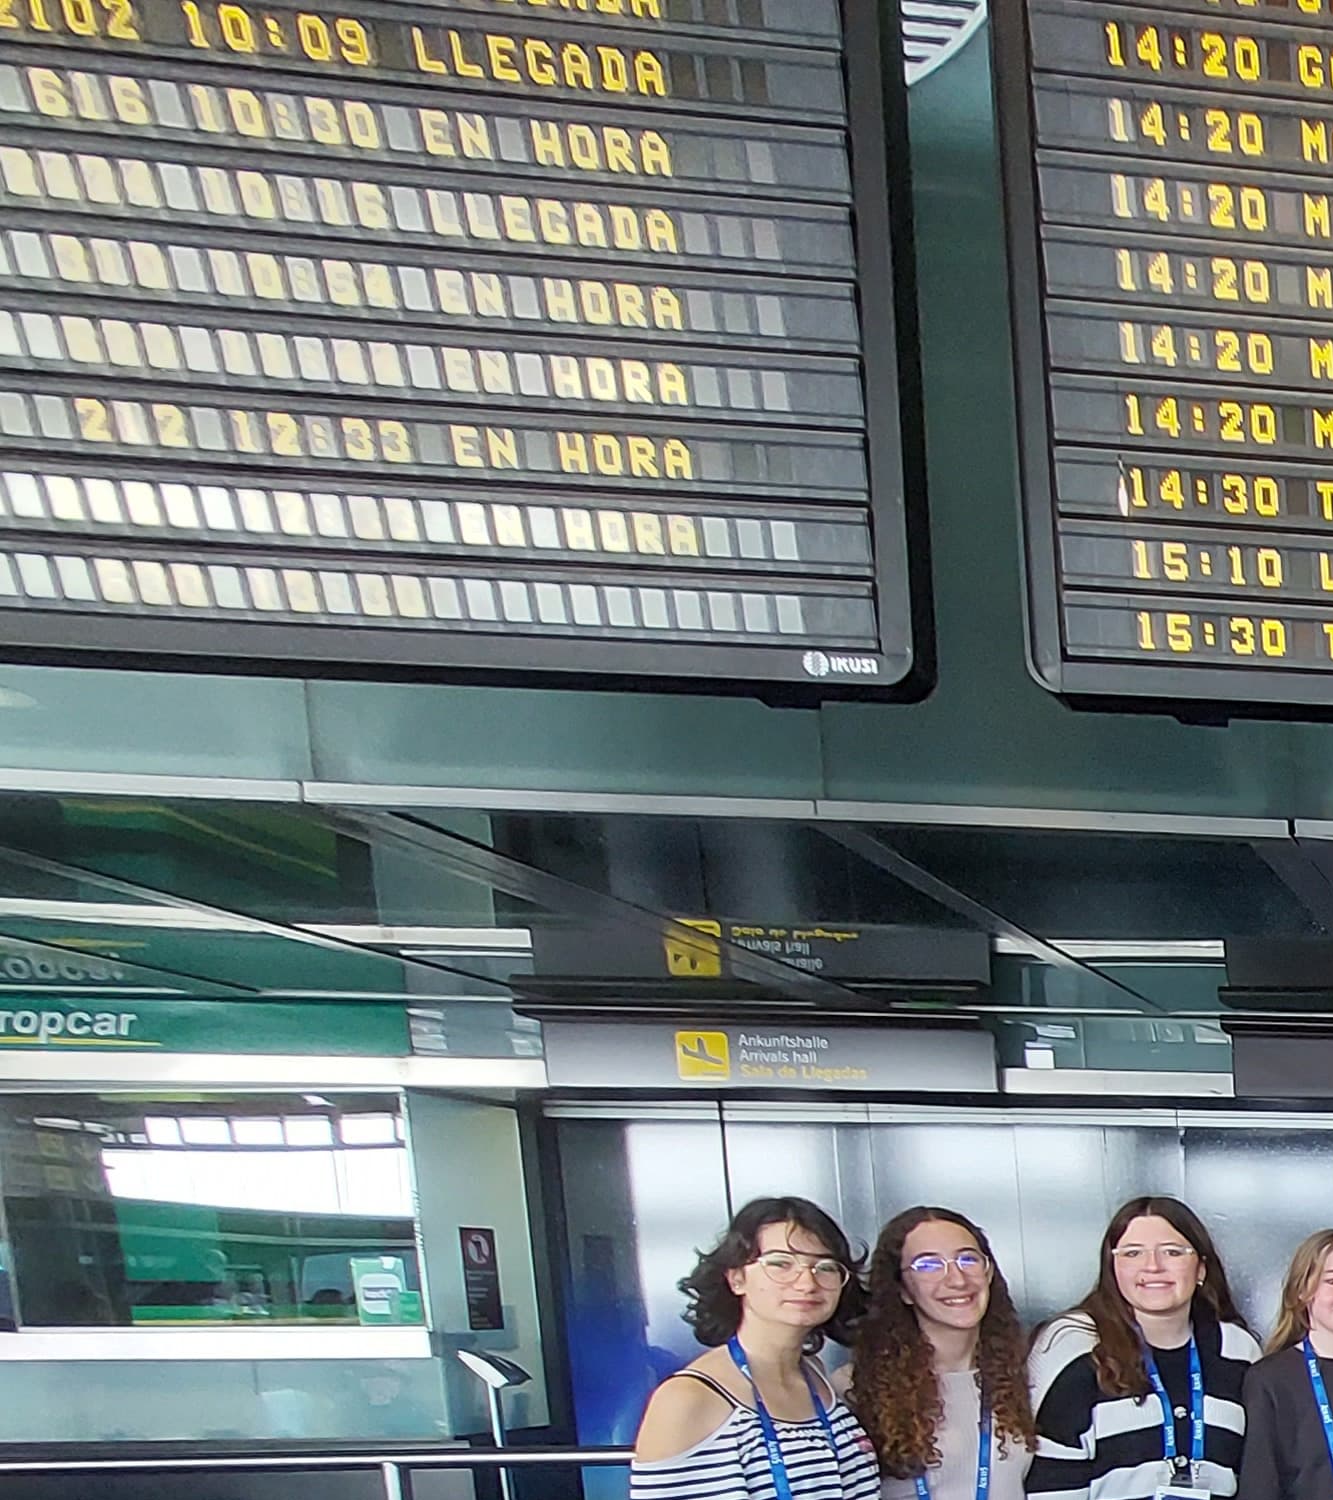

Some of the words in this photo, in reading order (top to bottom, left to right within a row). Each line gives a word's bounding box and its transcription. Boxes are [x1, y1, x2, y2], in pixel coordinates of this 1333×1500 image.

[183, 2, 368, 64] 10:09
[415, 32, 666, 95] LLEGADA
[1108, 24, 1259, 80] 14:20
[28, 65, 150, 126] 616
[190, 83, 380, 149] 10:30
[420, 108, 491, 158] EN
[529, 120, 674, 178] HORA
[1108, 98, 1265, 157] 14:20
[423, 185, 679, 255] LLEGADA
[1110, 173, 1267, 232] 14:20
[432, 264, 503, 319] EN
[544, 274, 682, 331] HORA
[1120, 252, 1270, 303] 14:20
[1126, 326, 1273, 373] 14:20
[549, 351, 687, 406] HORA
[72, 399, 191, 448] 212
[227, 406, 412, 463] 12:33
[451, 423, 518, 469] EN
[557, 432, 693, 481] HORA
[1130, 397, 1276, 442] 14:20
[1133, 471, 1277, 517] 14:30
[564, 509, 699, 558] HORA
[1136, 544, 1283, 588] 15:10
[1142, 615, 1285, 656] 15:30
[831, 656, 880, 676] IKUSI
[738, 1033, 829, 1049] Ankunftshalle
[739, 1049, 790, 1063] Arrivals
[793, 1051, 817, 1064] hall
